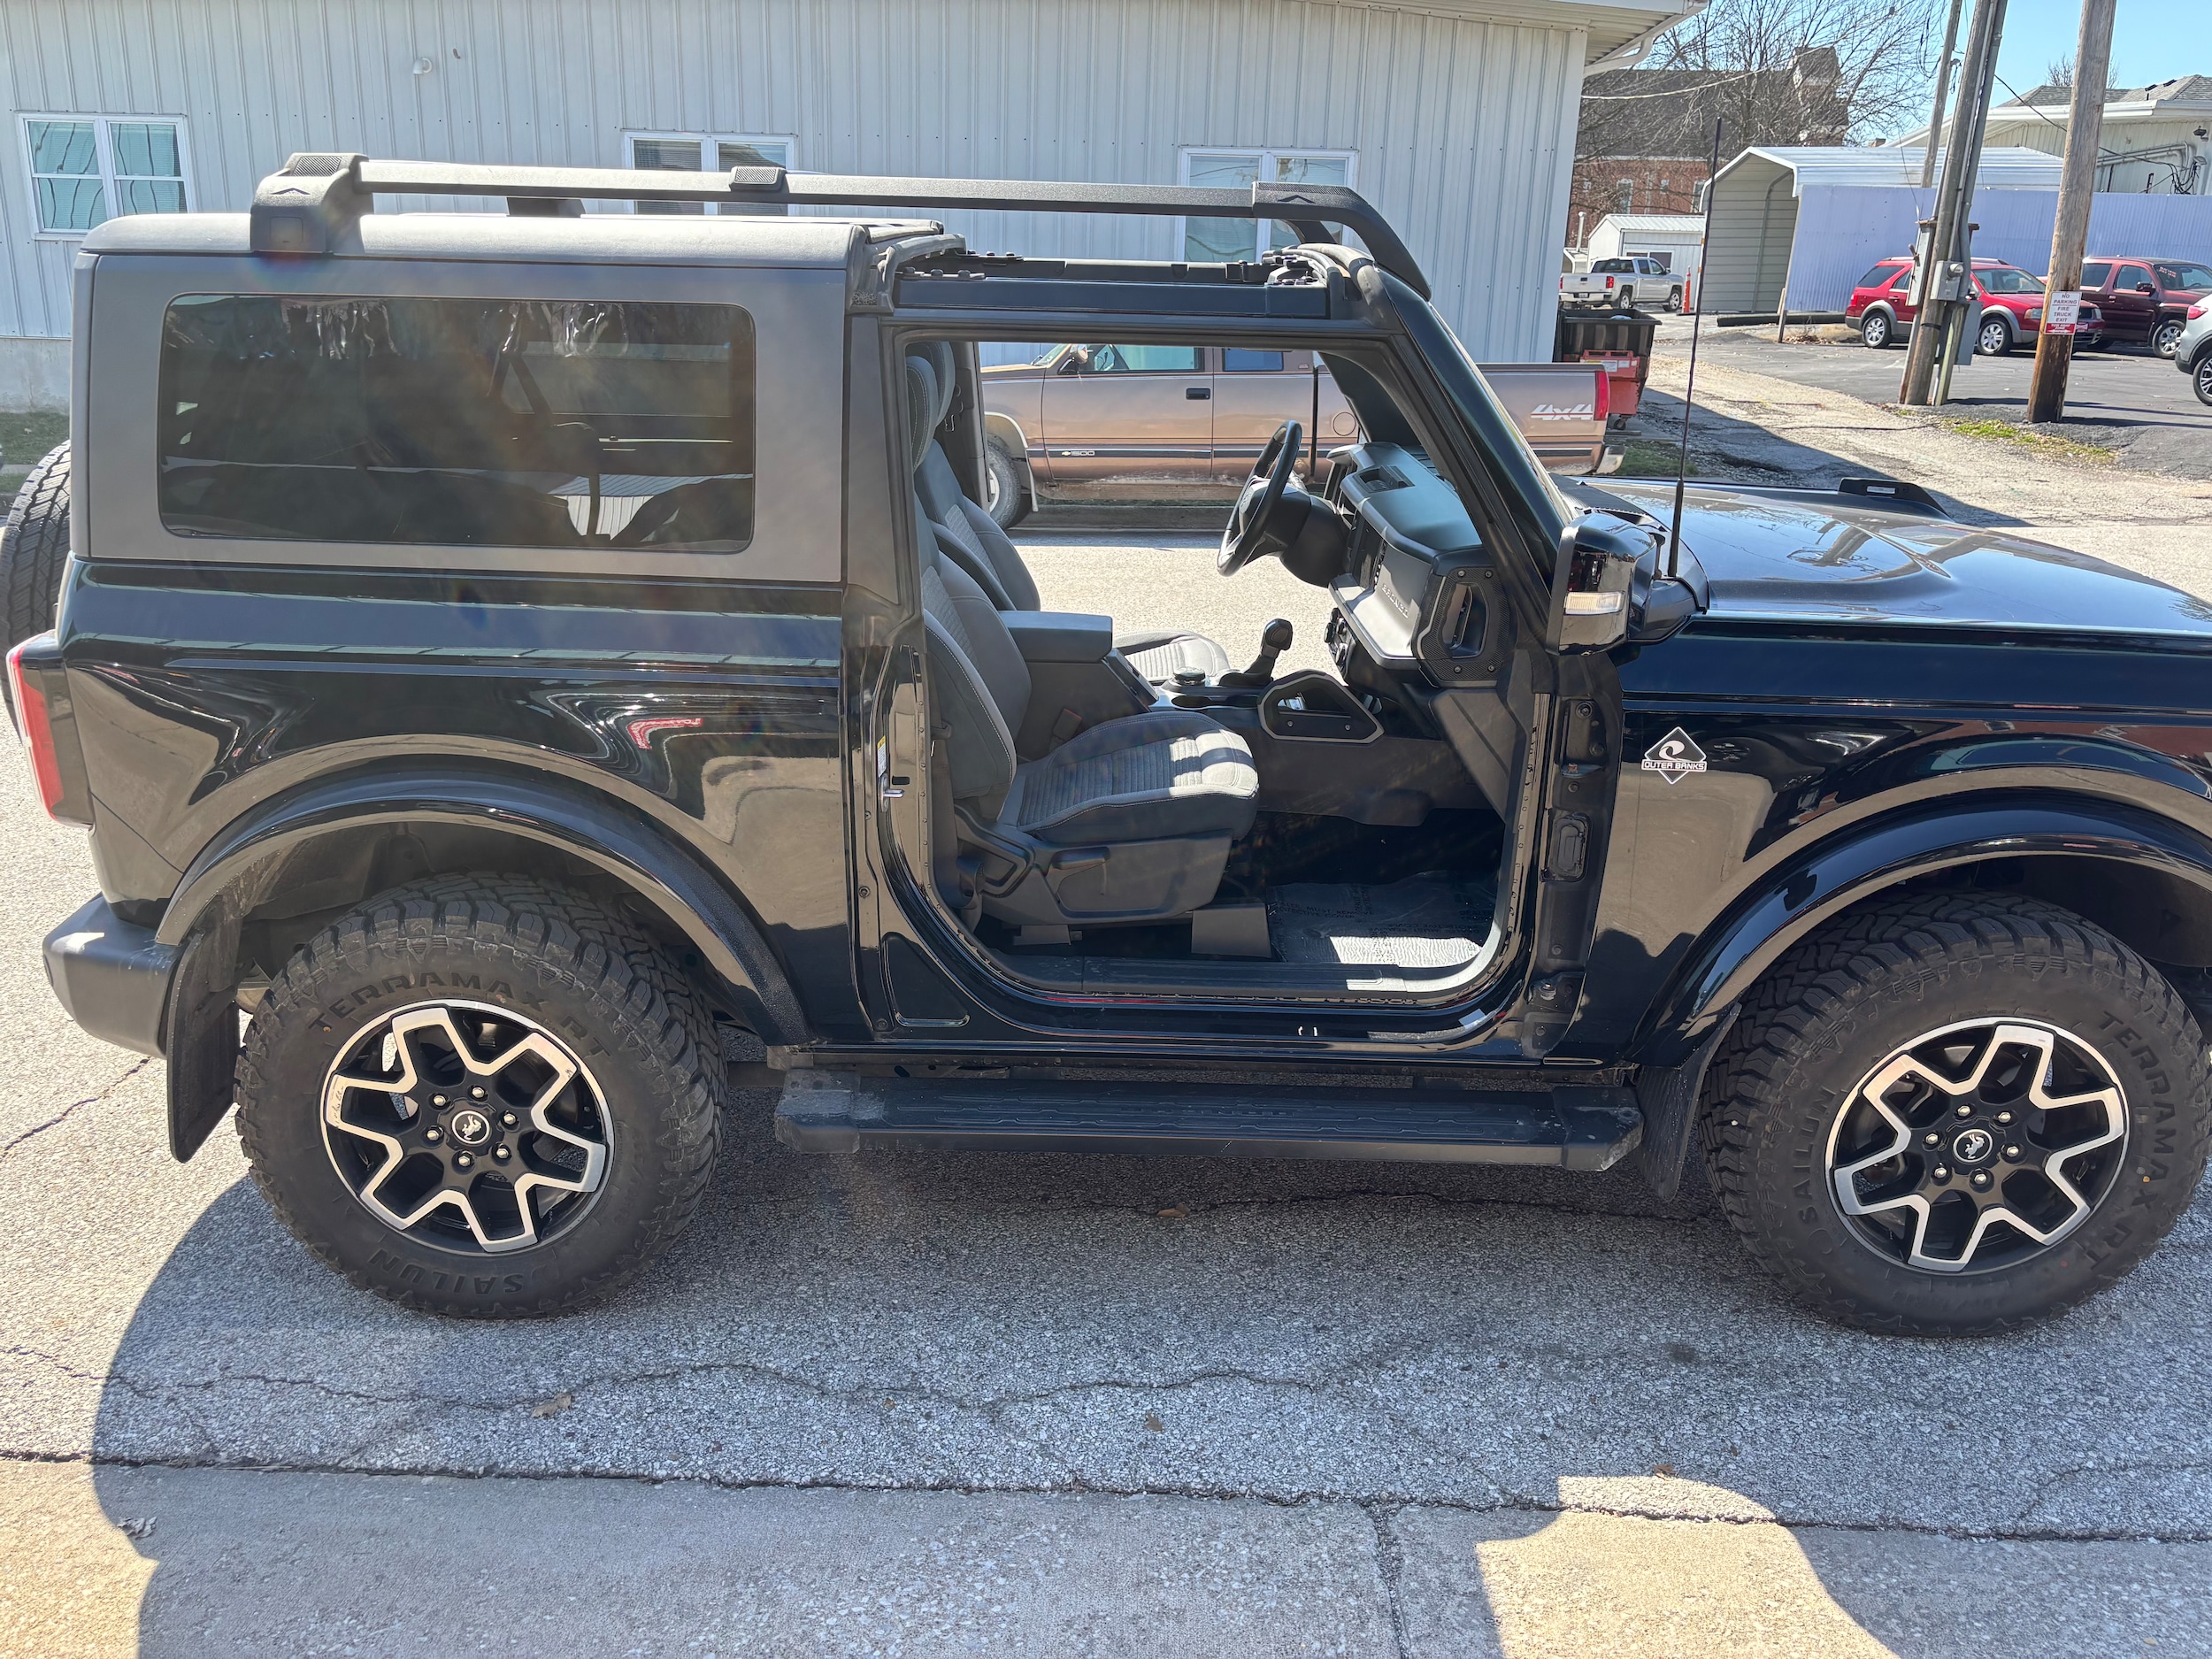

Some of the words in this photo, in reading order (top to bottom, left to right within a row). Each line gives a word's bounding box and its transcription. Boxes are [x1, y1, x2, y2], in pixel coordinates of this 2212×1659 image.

[1530, 403, 1594, 421] 4x4
[1381, 583, 1409, 619] BRONCO
[1674, 762, 1705, 771] BANKS
[310, 971, 550, 1031] TERRAMAX
[557, 1017, 612, 1058] RT
[2099, 1010, 2177, 1211] TERRAMAX
[1793, 1085, 1839, 1225] SAILUN
[367, 1248, 526, 1295] SAILUN
